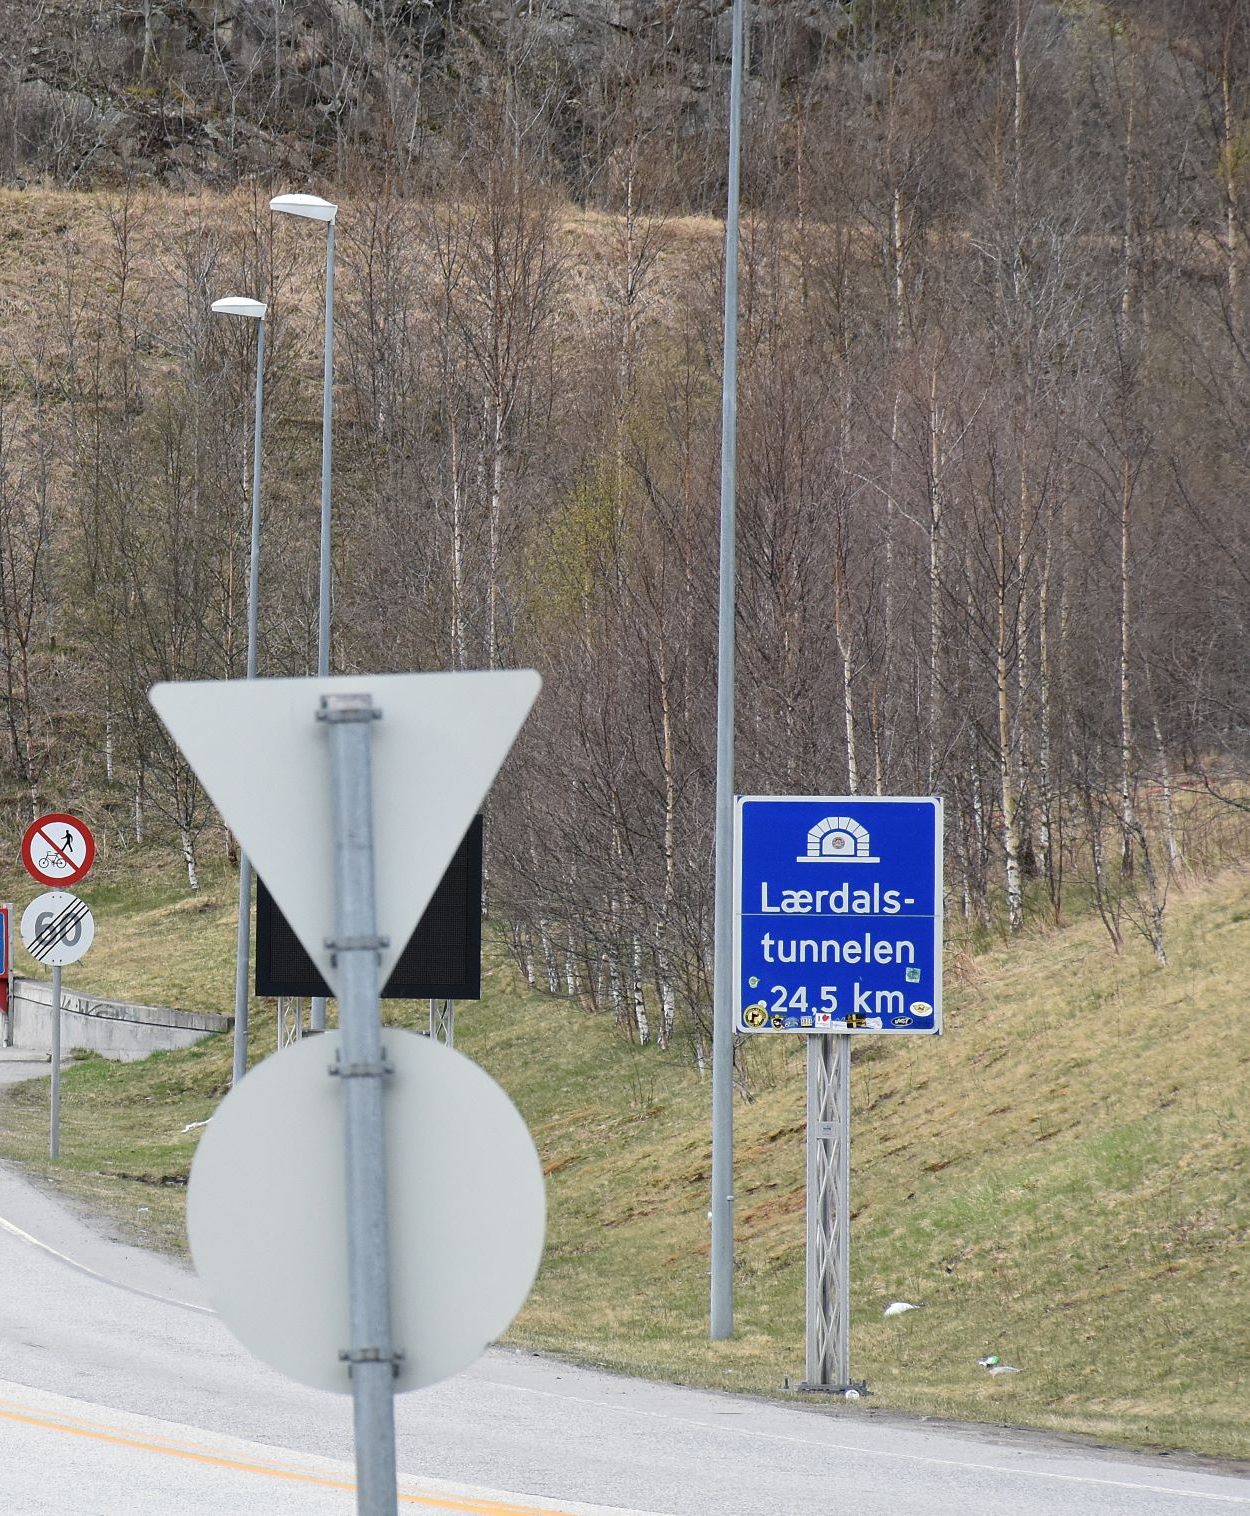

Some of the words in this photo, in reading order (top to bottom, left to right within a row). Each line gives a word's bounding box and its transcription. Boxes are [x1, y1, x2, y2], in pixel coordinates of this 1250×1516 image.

[760, 881, 915, 914] Lærdals-
[34, 911, 82, 947] 60
[760, 931, 915, 964] tunnelen
[770, 985, 838, 1015] 24,5
[853, 982, 904, 1014] km
